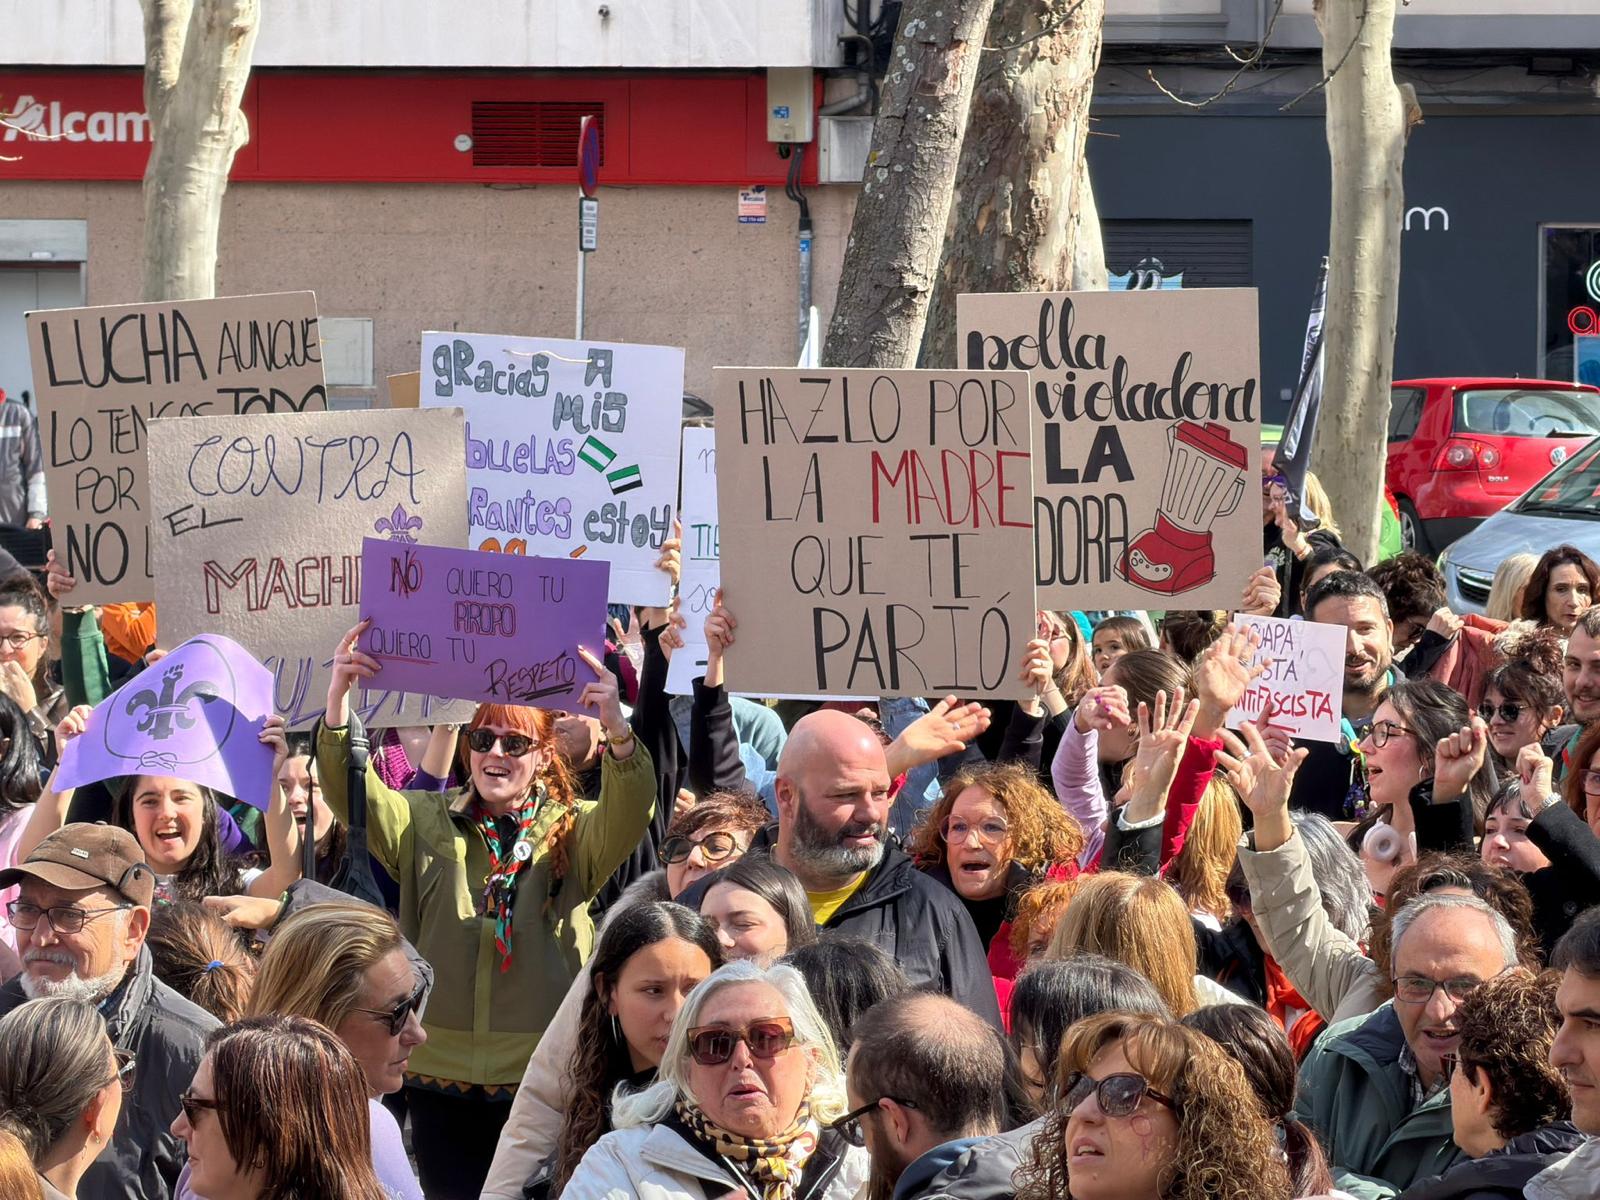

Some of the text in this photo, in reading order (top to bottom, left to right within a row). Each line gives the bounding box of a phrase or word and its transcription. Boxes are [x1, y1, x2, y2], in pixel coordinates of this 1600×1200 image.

[41, 309, 322, 388] LUCHA AUNQUE
[584, 348, 613, 388] A
[738, 376, 1018, 447] HAZLO POR
[1034, 351, 1257, 422] violadora
[50, 410, 92, 467] LO
[188, 431, 425, 504] CONTRA
[1044, 422, 1135, 485] LA
[75, 467, 140, 513] POR
[163, 504, 243, 537] EL
[763, 449, 1033, 529] LA MADRE
[66, 522, 129, 585] NO
[791, 533, 980, 599] QUE TE
[1034, 493, 1129, 587] DORA
[446, 567, 513, 599] QUIERO
[539, 575, 566, 603] TU
[369, 627, 476, 664] QUIERO TU
[453, 600, 516, 637] PIROPO
[813, 591, 1011, 691] PARIÓ
